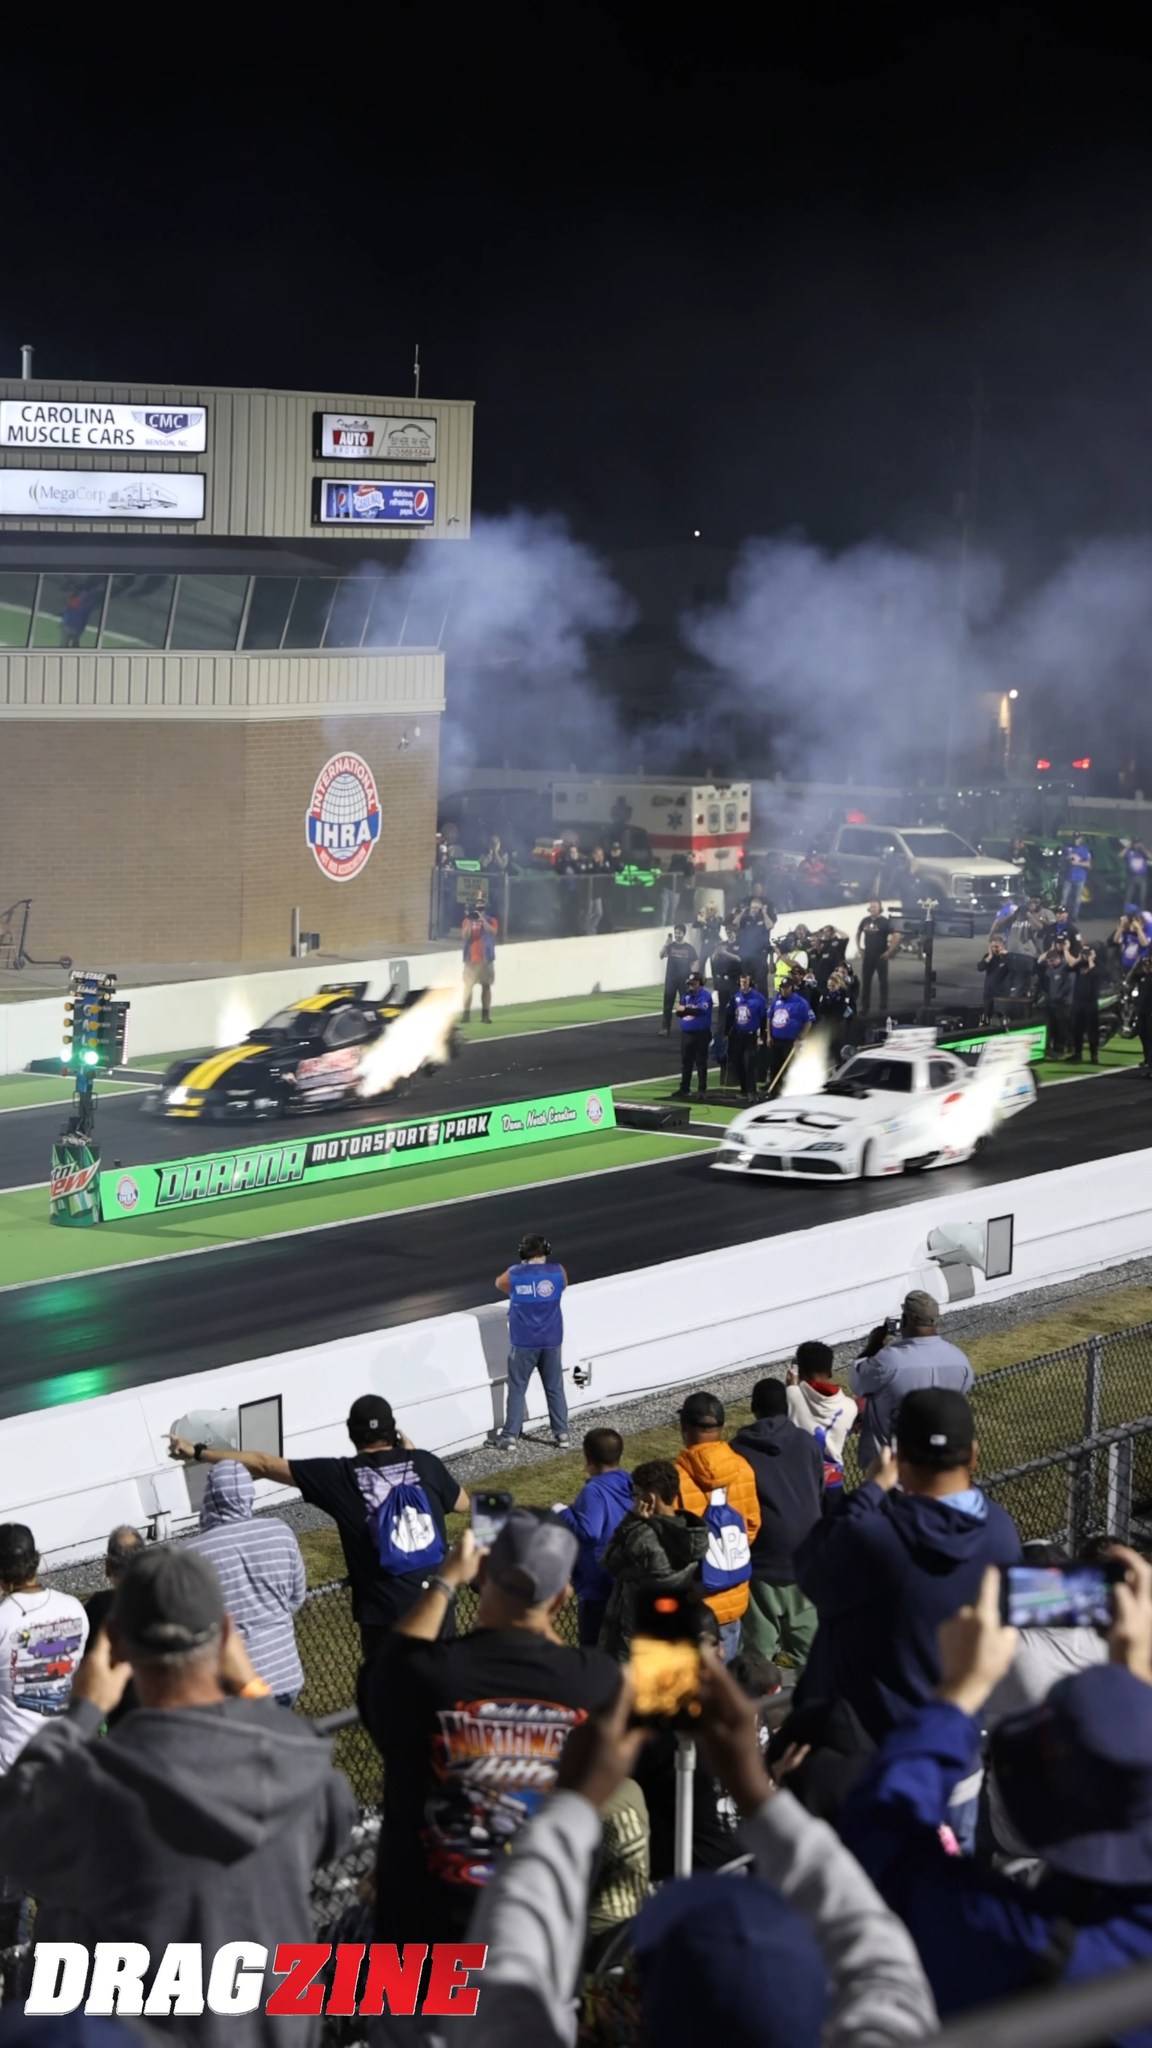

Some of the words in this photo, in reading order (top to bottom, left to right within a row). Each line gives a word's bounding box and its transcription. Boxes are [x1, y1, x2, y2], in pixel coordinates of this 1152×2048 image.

[21, 406, 115, 424] CAROLINA
[148, 413, 184, 428] CMC
[8, 425, 81, 443] MUSCLE
[87, 428, 135, 445] CARS
[145, 439, 176, 447] BENSON,
[339, 431, 368, 446] AUTO
[40, 485, 106, 503] MegaCorp
[313, 758, 377, 812] INTERNATIONAL
[315, 819, 372, 848] IHRA
[71, 970, 107, 981] PRE-STAGE
[76, 985, 98, 994] STAGE
[527, 1109, 547, 1127] North
[548, 1106, 577, 1123] Carolina
[158, 1144, 307, 1205] DARANA
[312, 1123, 439, 1161] MOTORSPORTS
[445, 1115, 488, 1138] PARK
